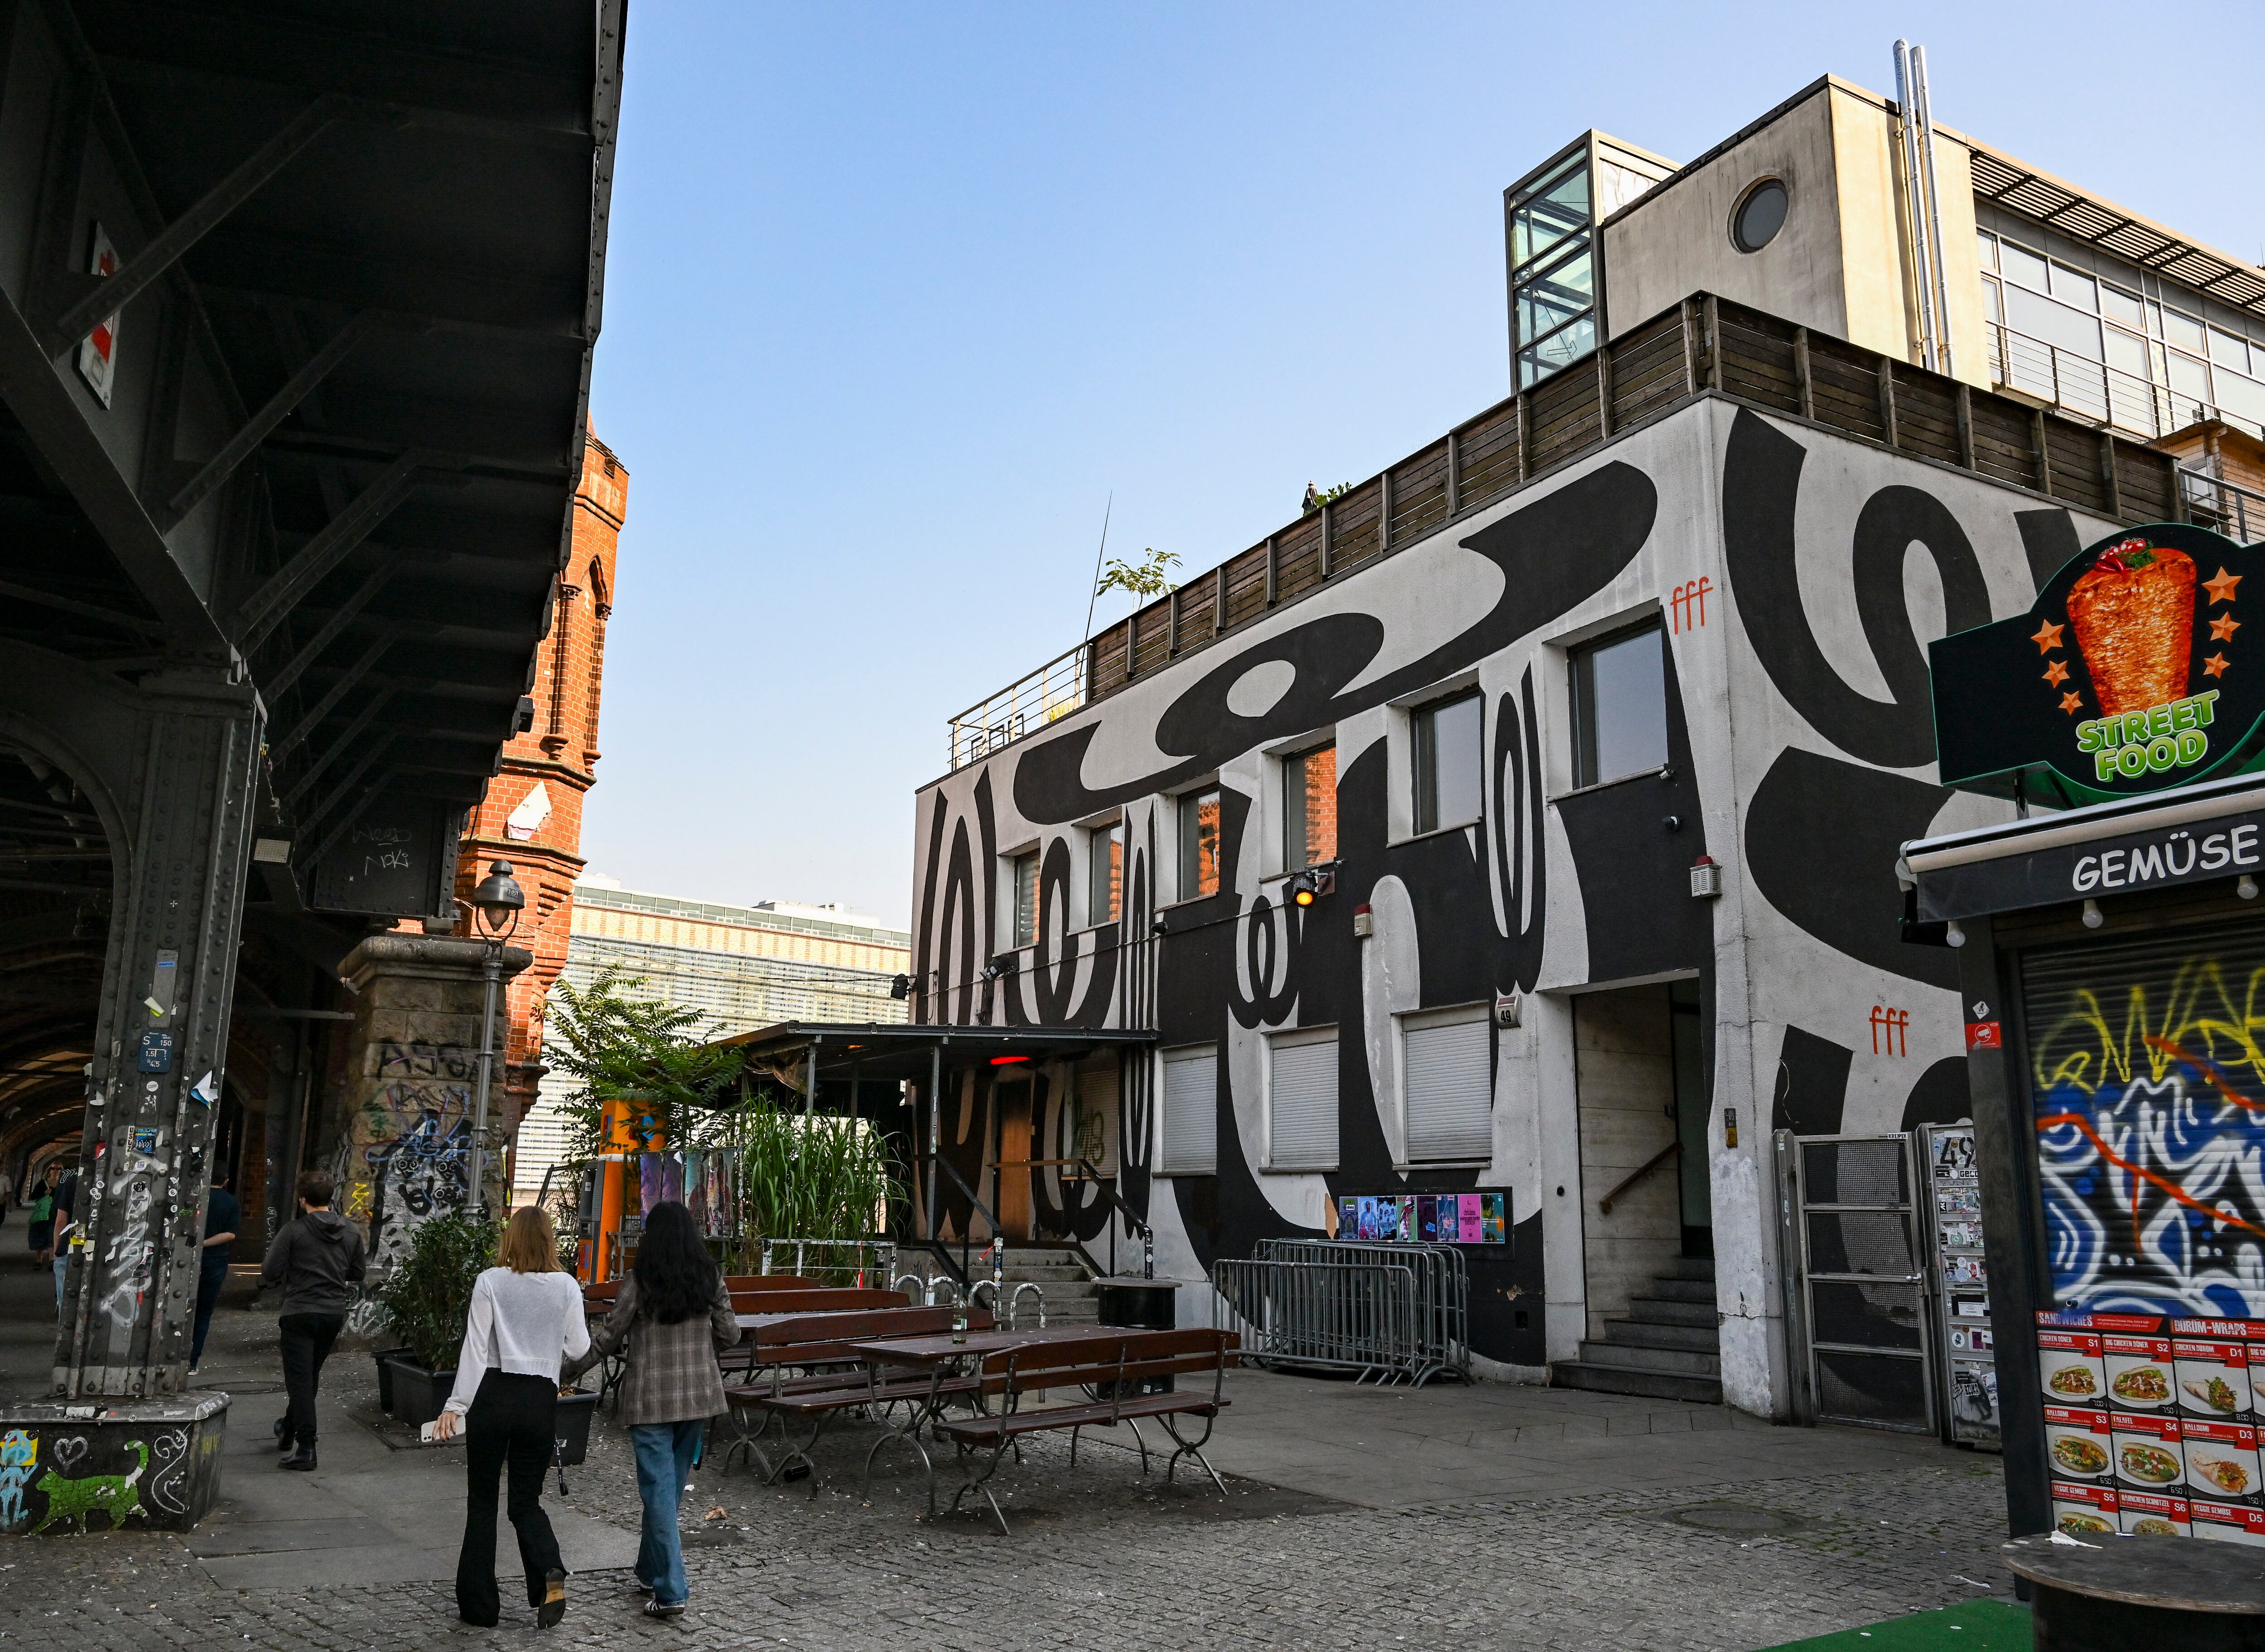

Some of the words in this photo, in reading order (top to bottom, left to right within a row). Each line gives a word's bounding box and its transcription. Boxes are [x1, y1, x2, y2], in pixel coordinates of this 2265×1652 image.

[1670, 576, 1714, 635] fff
[2076, 689, 2220, 753] STREET
[2095, 729, 2208, 782] FOOD
[2072, 824, 2260, 891] GEMÜSE
[1501, 1010, 1512, 1022] 49
[1869, 1005, 1909, 1057] fff
[143, 1036, 151, 1045] S
[1940, 1137, 1976, 1169] 49
[2038, 1312, 2093, 1327] SANDWICHES
[2174, 1319, 2247, 1336] DÜRÜM-WRAPS
[2088, 1339, 2098, 1348] S1
[2157, 1344, 2169, 1352] S2
[2230, 1348, 2242, 1357] D1
[2096, 1415, 2106, 1424] S3
[2113, 1416, 2133, 1424] FALAFEL
[2165, 1422, 2177, 1431] S4
[2239, 1430, 2252, 1439] D3
[2053, 1485, 2069, 1493] VEGGIE
[2103, 1493, 2115, 1502] S5
[2145, 1498, 2170, 1507] SCHNITZEL
[2174, 1503, 2186, 1512] S6
[2193, 1504, 2211, 1513] VEGGIE
[2249, 1513, 2263, 1523] D5
